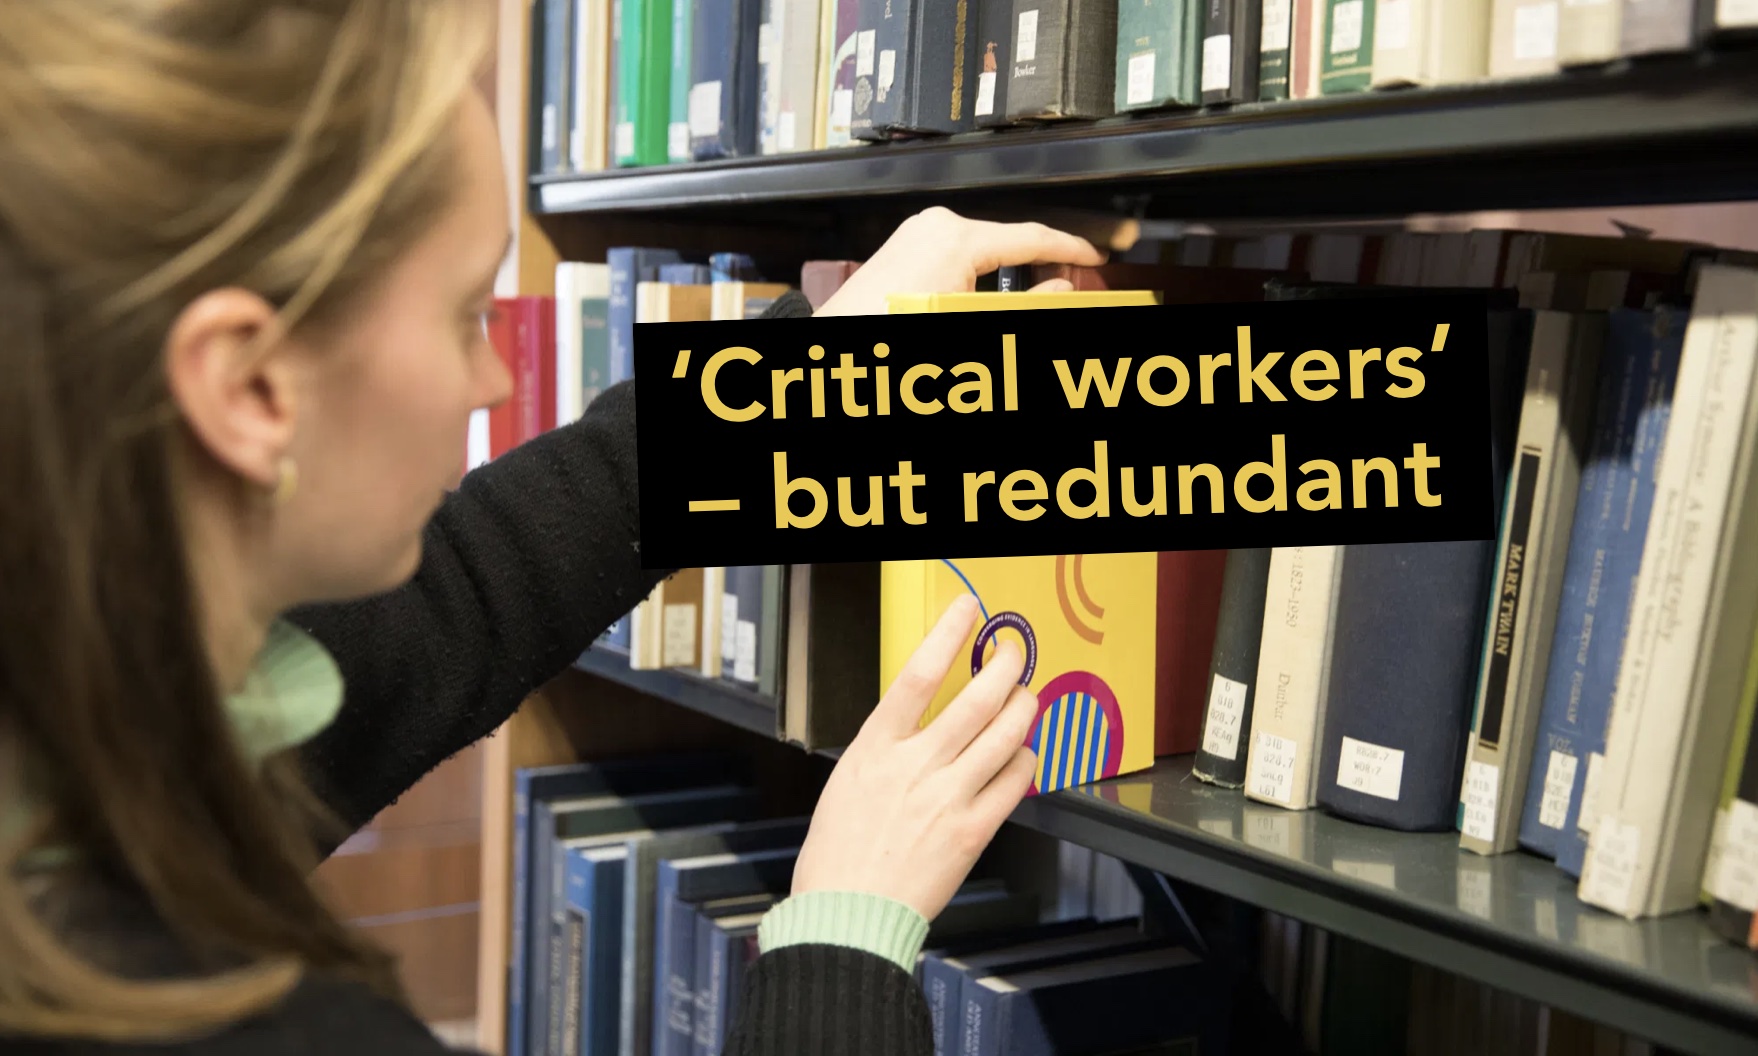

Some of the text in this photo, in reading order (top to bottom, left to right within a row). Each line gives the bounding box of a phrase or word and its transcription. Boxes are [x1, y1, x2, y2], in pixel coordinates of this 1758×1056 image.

[1496, 544, 1523, 655] MARK TWAIN
[1004, 613, 1026, 629] EVIDENCE
[1028, 633, 1036, 668] LANGUAGE
[1274, 672, 1291, 721] Dunbar
